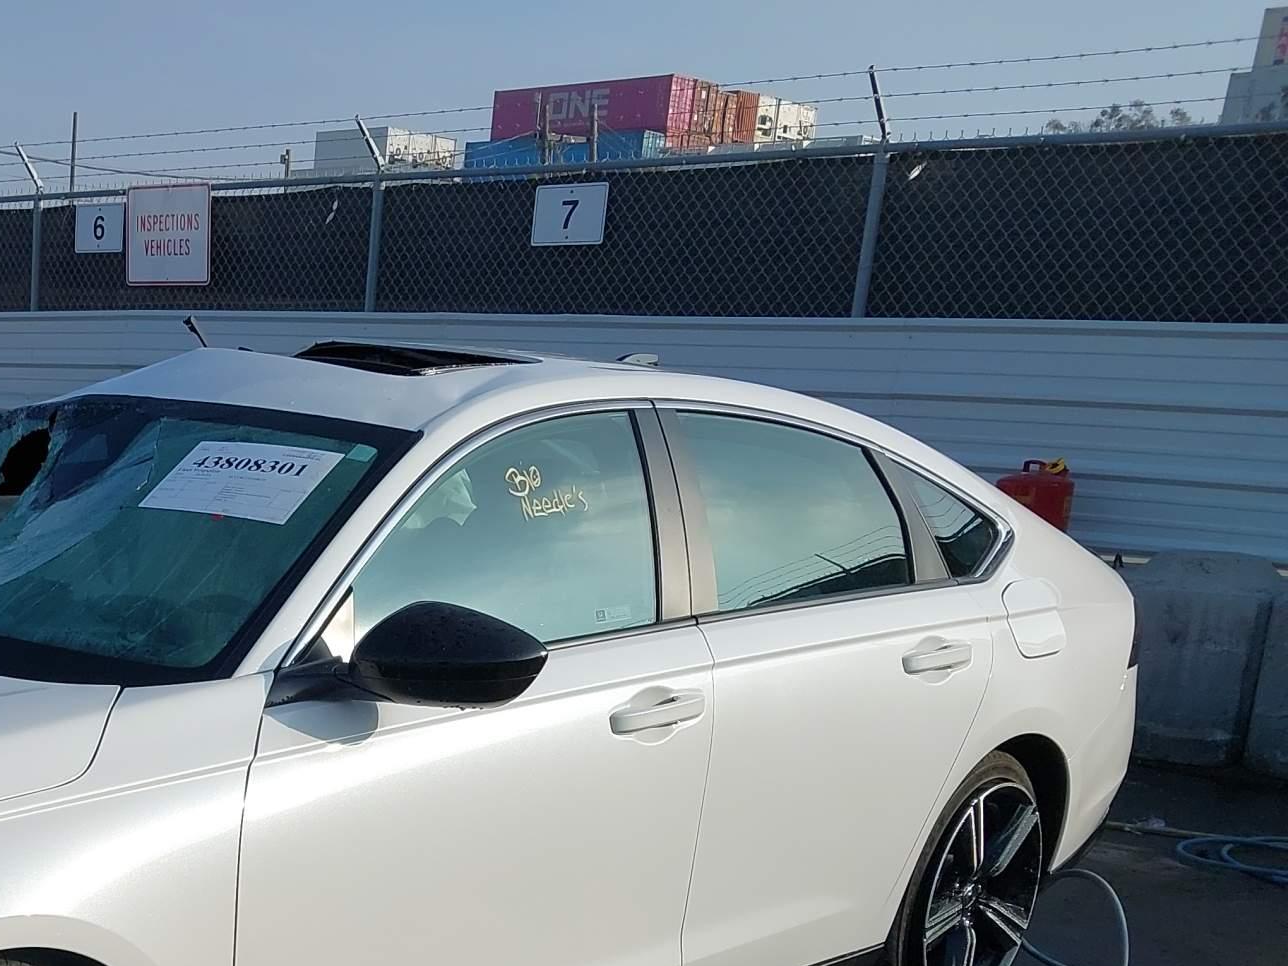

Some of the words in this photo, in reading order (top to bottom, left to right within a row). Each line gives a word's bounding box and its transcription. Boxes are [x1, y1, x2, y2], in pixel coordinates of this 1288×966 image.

[136, 213, 200, 232] INSPECTIONS
[562, 200, 580, 230] 7
[93, 215, 105, 241] 6
[144, 239, 191, 257] VEHICLES
[193, 455, 309, 477] 43808301
